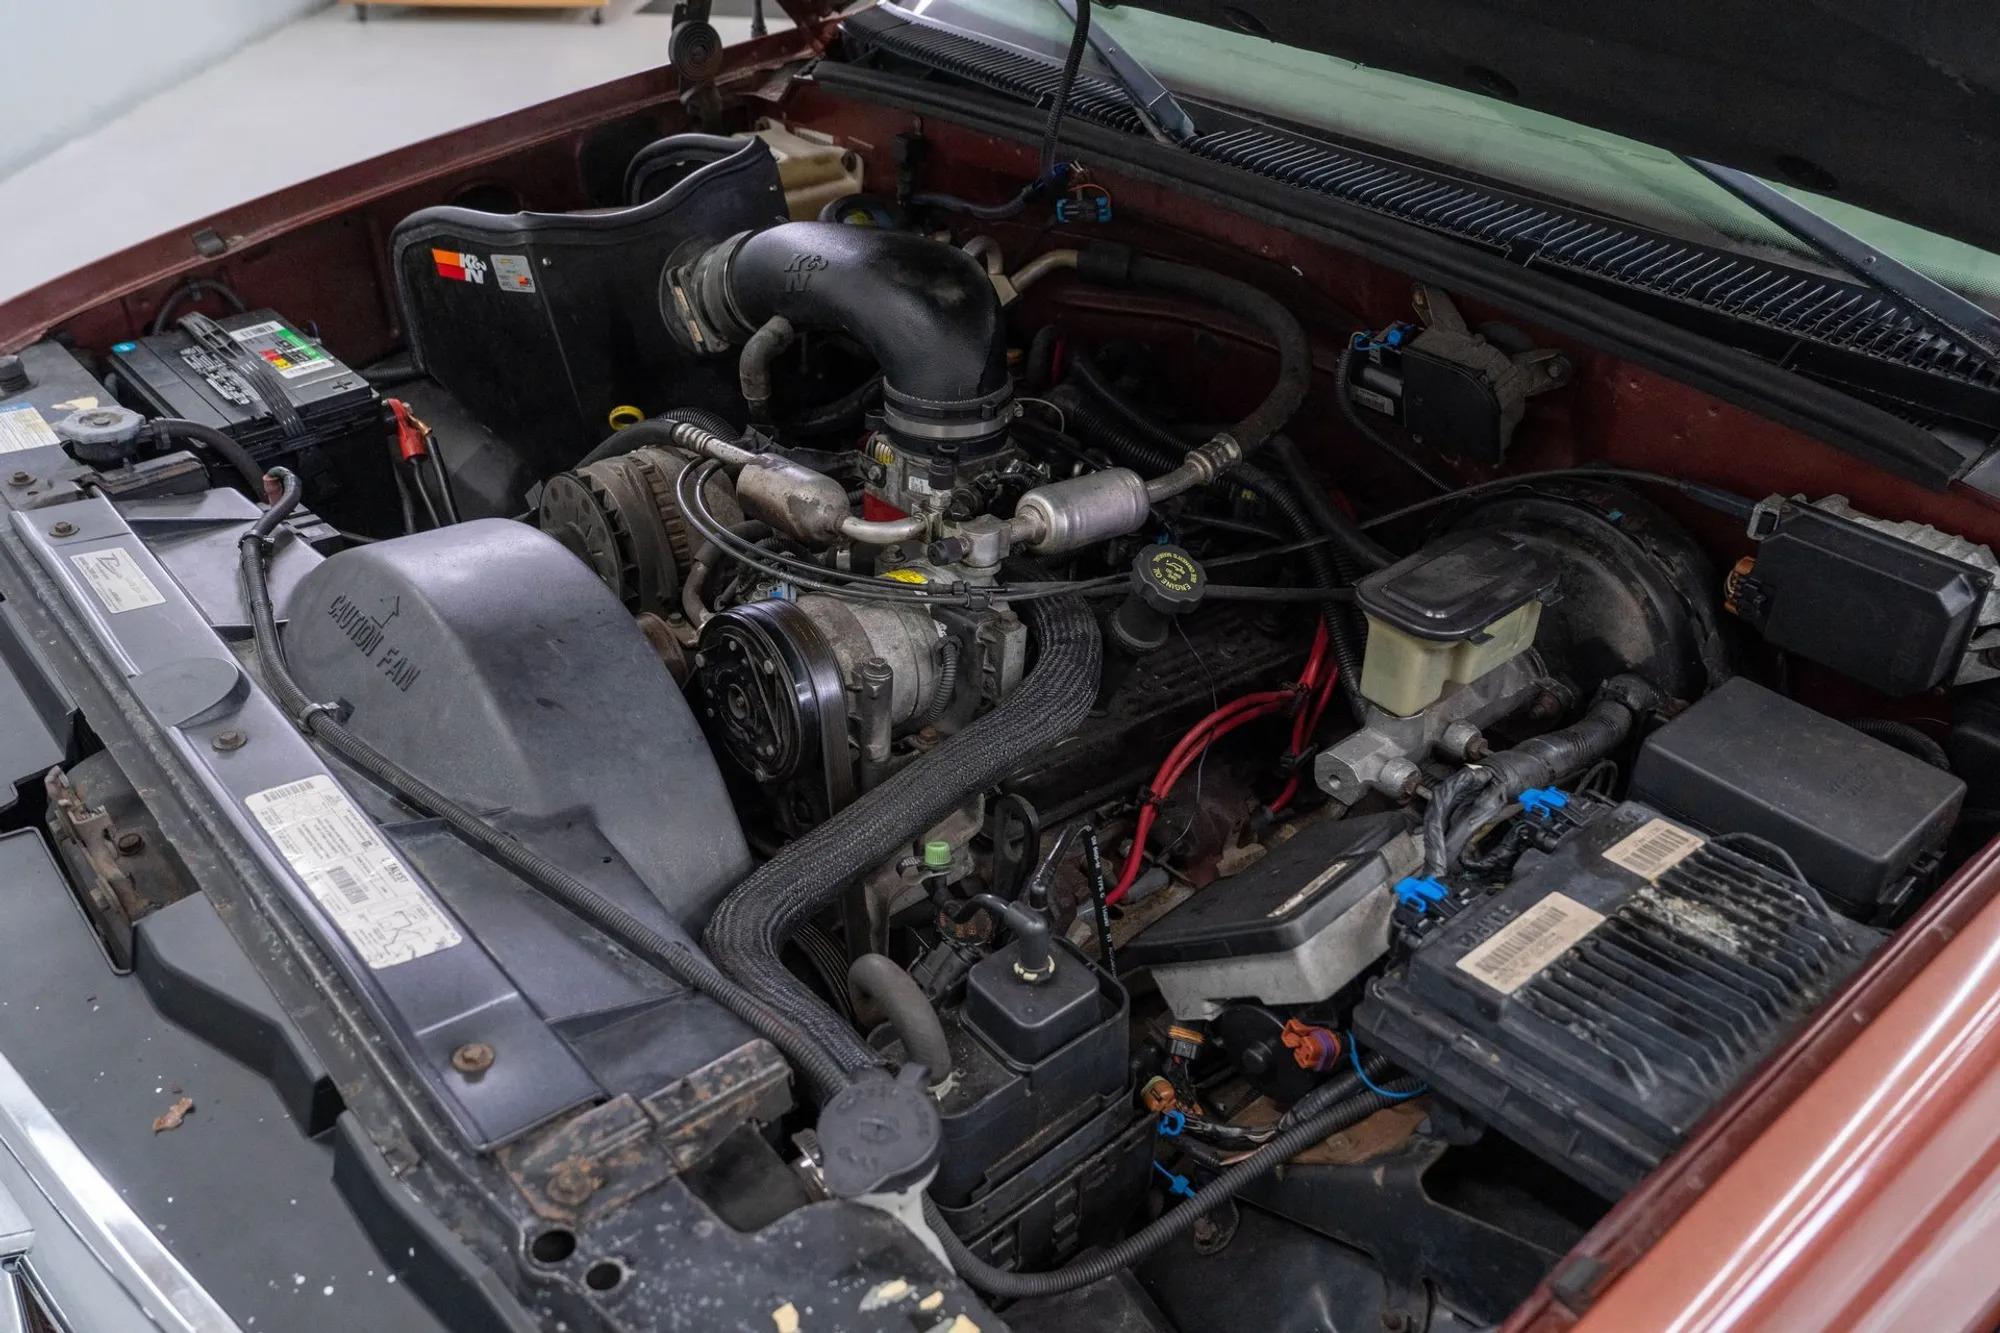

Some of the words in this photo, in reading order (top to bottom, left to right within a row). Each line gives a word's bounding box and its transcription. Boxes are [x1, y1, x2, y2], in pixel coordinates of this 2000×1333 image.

[1152, 567, 1163, 579] OIL
[1160, 578, 1191, 591] ENGINE
[327, 595, 385, 657] CAUTION
[376, 647, 421, 692] FAN
